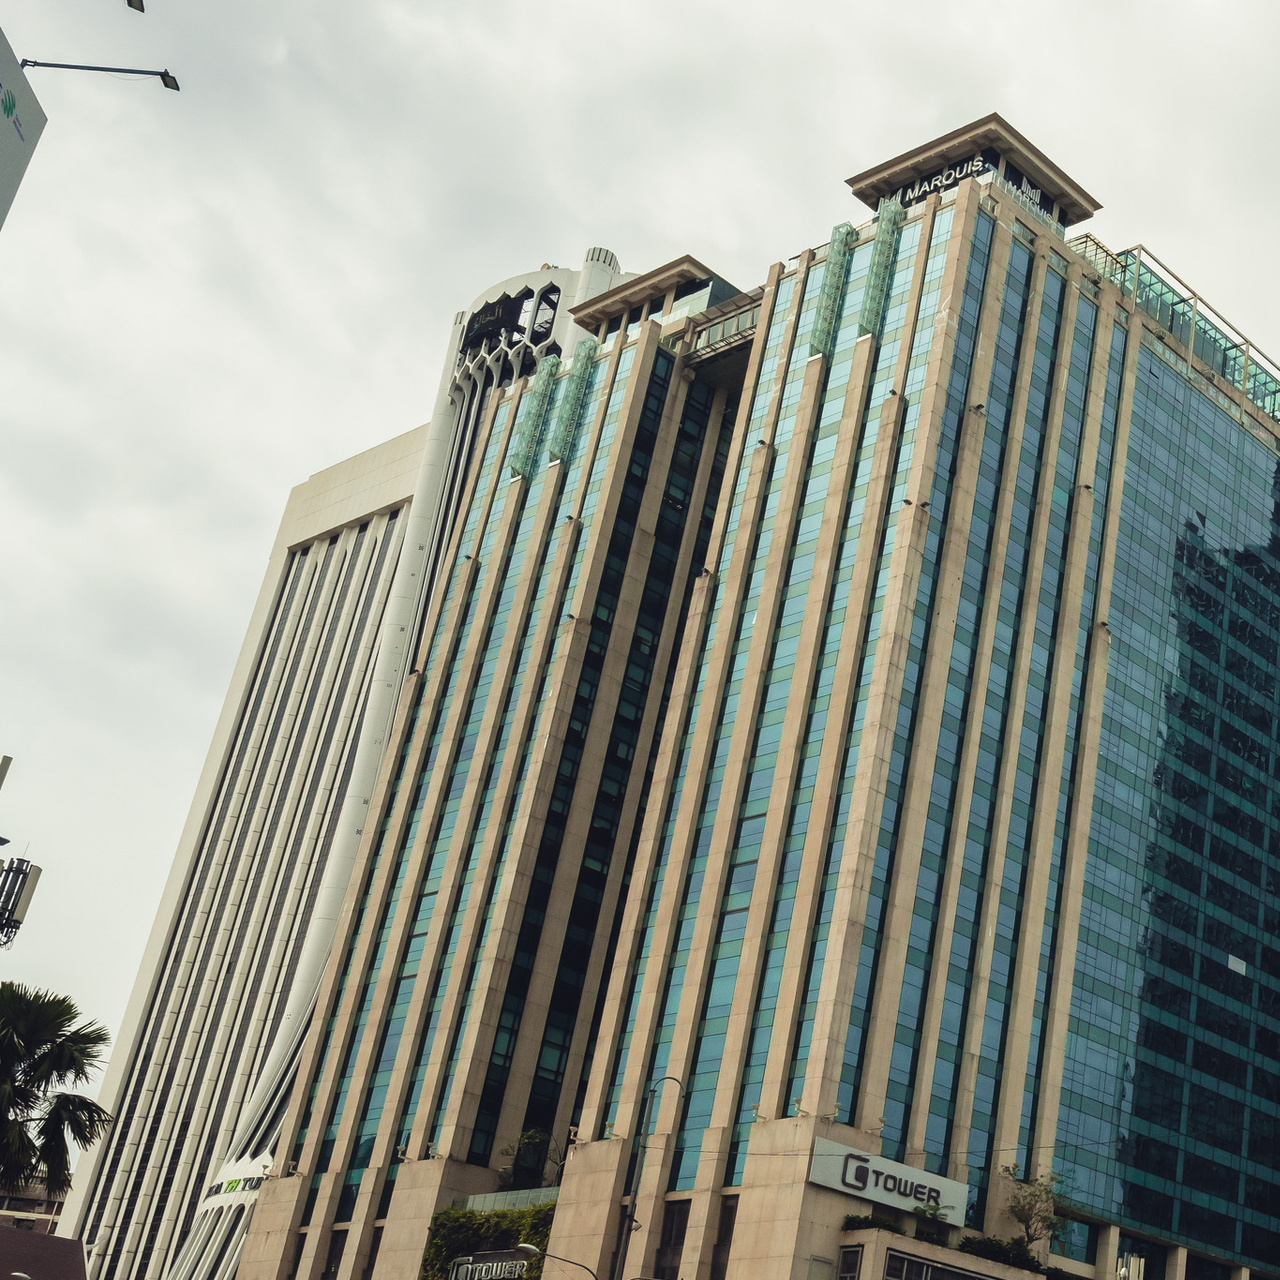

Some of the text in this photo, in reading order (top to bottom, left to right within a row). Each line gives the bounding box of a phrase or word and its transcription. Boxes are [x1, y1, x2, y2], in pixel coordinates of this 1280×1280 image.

[904, 156, 985, 202] MARQUIS
[224, 1179, 241, 1193] TH
[872, 1170, 941, 1205] TOWER
[471, 1260, 527, 1280] TOWER
